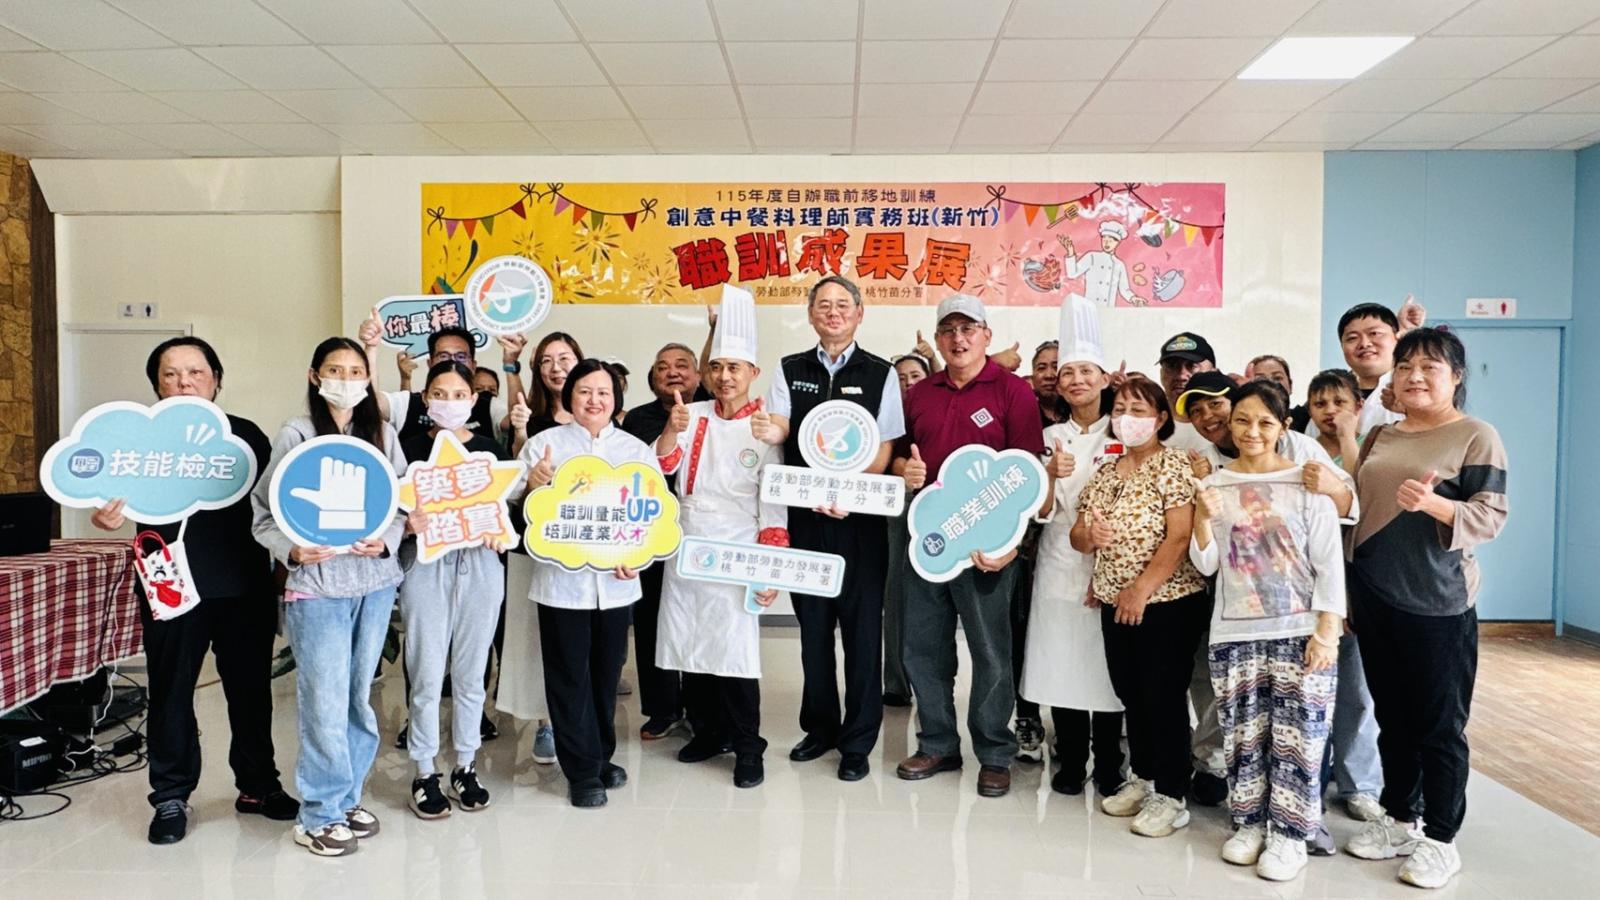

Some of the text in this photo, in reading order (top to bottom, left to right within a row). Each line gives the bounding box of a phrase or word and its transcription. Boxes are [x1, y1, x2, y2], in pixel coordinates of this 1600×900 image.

[716, 188, 936, 204] 115年度自辦職前移地訓練
[667, 206, 999, 228] 創意中餐料理師實務班(新竹)
[673, 228, 971, 291] 職訓成果展
[385, 301, 460, 339] 你最棒
[109, 449, 238, 481] 技能檢定
[414, 460, 493, 504] 築夢
[770, 472, 897, 495] 勞動部勞動力發展署
[769, 486, 896, 508] 桃竹苗分署
[940, 463, 1029, 541] 職業訓練
[425, 503, 503, 547] 踏實
[544, 523, 645, 541] 培訓產業人才
[720, 563, 830, 586] 桃竹苗分署
[721, 551, 832, 575] 勞動部勞動力發展署
